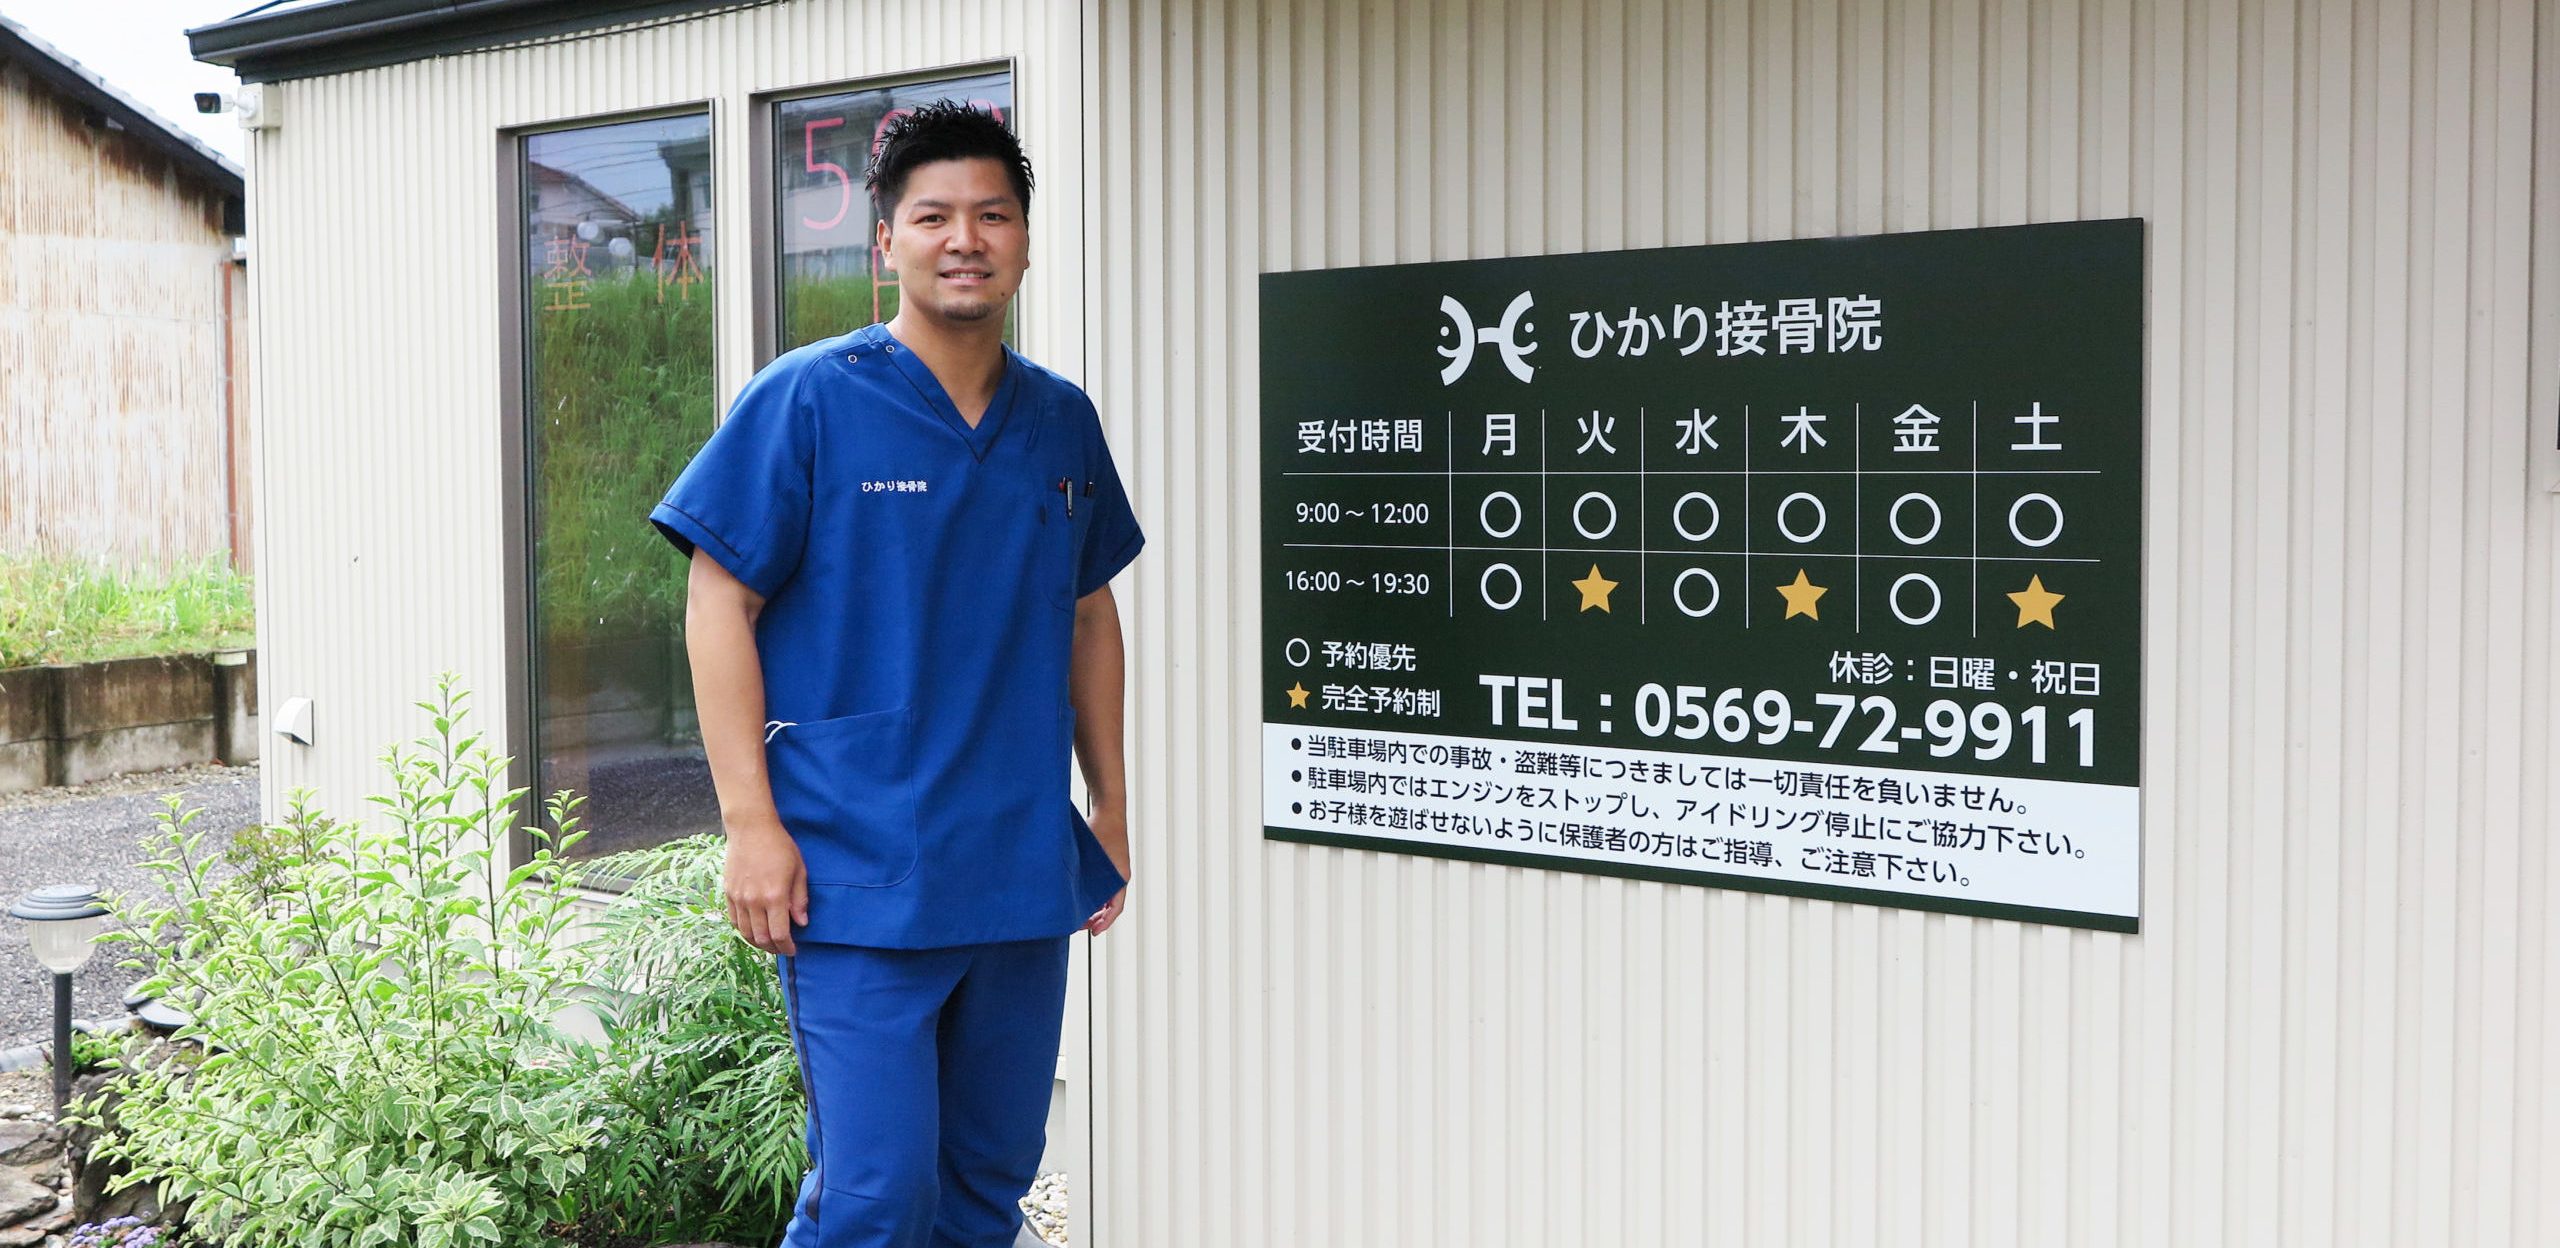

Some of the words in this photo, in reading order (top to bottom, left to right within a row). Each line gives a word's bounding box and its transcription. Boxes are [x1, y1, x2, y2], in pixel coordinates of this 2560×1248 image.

[1569, 293, 1882, 359] ひかり接骨院
[1298, 418, 1423, 454] 受付時間
[1481, 413, 1516, 456] 月
[1576, 410, 1617, 455] 火
[1675, 408, 1719, 455] 水
[1780, 405, 1827, 454] 木
[1892, 403, 1941, 452] 金
[2010, 401, 2063, 451] 土
[861, 480, 928, 493] ひかり接骨院
[1321, 641, 1417, 672] 予約優先
[1321, 683, 1441, 718] 完全予約制
[1634, 682, 2095, 768] 0569-72-9911
